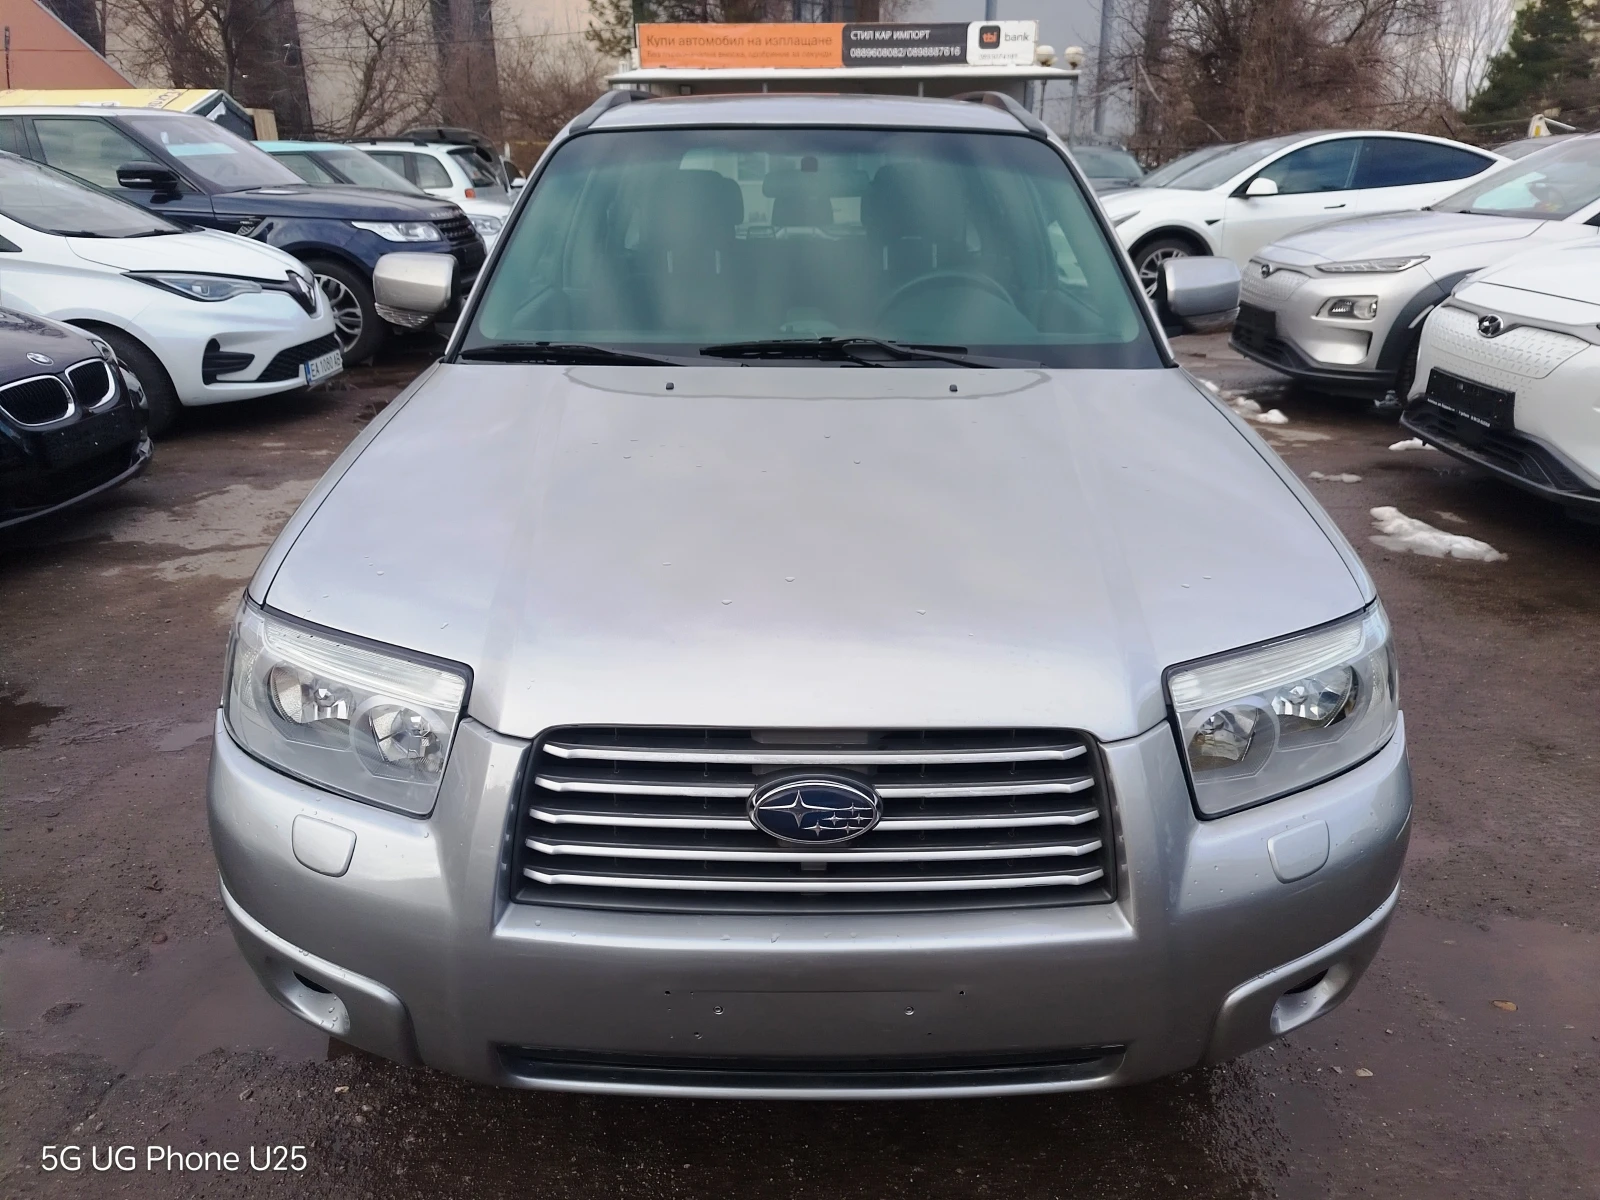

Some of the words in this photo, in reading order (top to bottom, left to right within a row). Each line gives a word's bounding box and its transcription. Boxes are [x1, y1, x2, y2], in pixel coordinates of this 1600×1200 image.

[850, 30, 874, 40] СТИЛ
[874, 30, 892, 40] КАР
[893, 29, 931, 40] ИМПОРТ
[982, 31, 998, 43] tbi
[1004, 31, 1030, 42] bank
[646, 35, 677, 48] Купи
[678, 35, 744, 47] автомобил
[747, 36, 762, 46] на
[765, 36, 832, 47] изплащане
